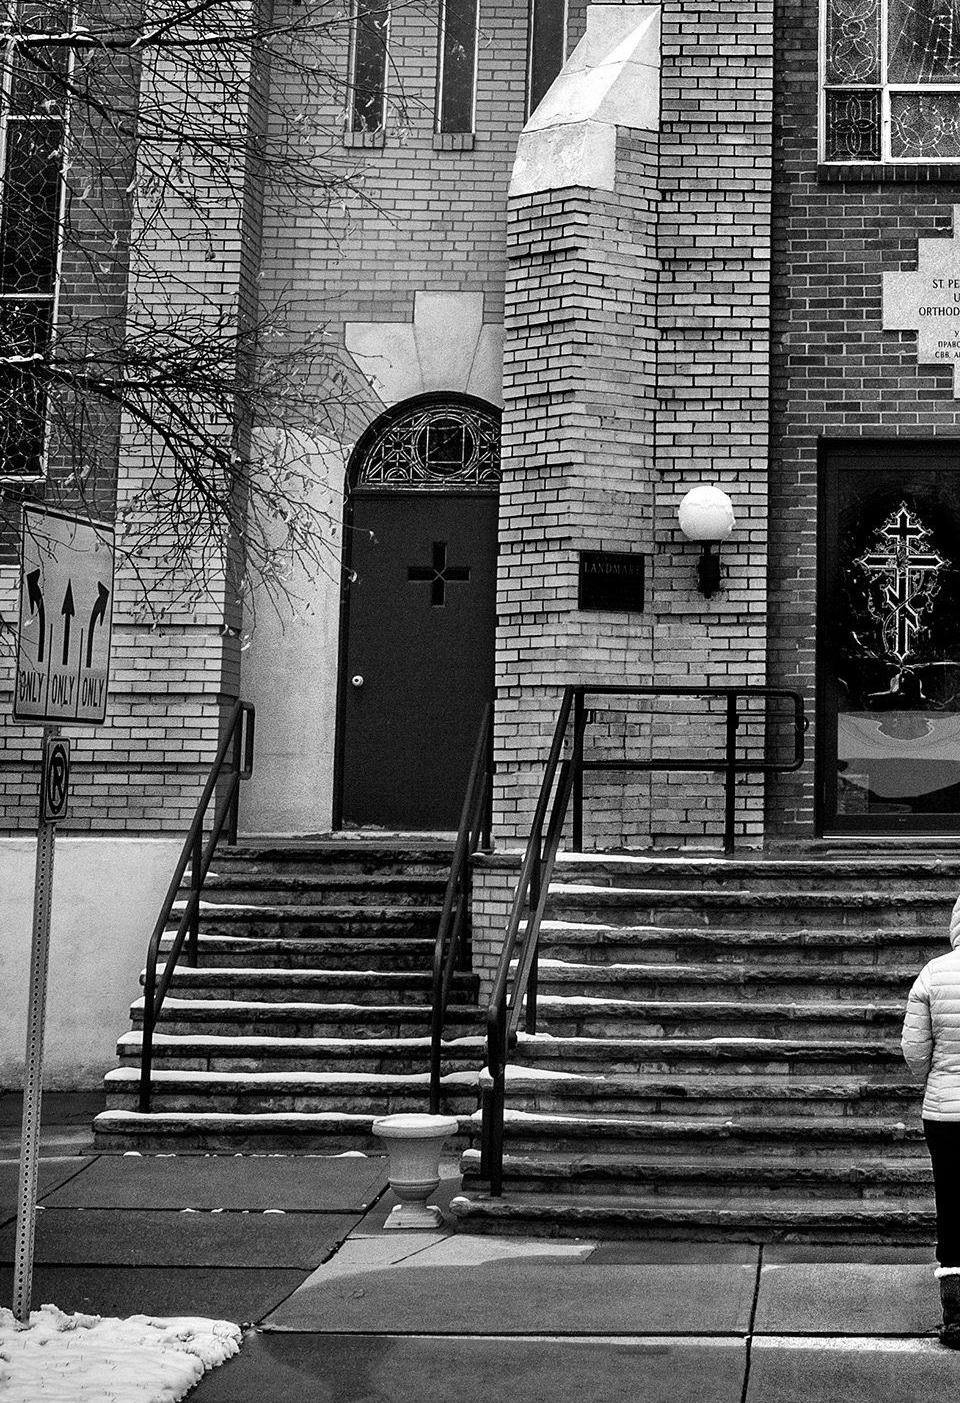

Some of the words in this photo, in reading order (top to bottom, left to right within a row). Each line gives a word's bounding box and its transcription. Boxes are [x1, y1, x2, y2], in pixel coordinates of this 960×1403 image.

[584, 562, 641, 574] LANDMARK
[19, 670, 45, 703] ONLY
[51, 674, 75, 705] ONLY
[81, 677, 105, 708] ONLY
